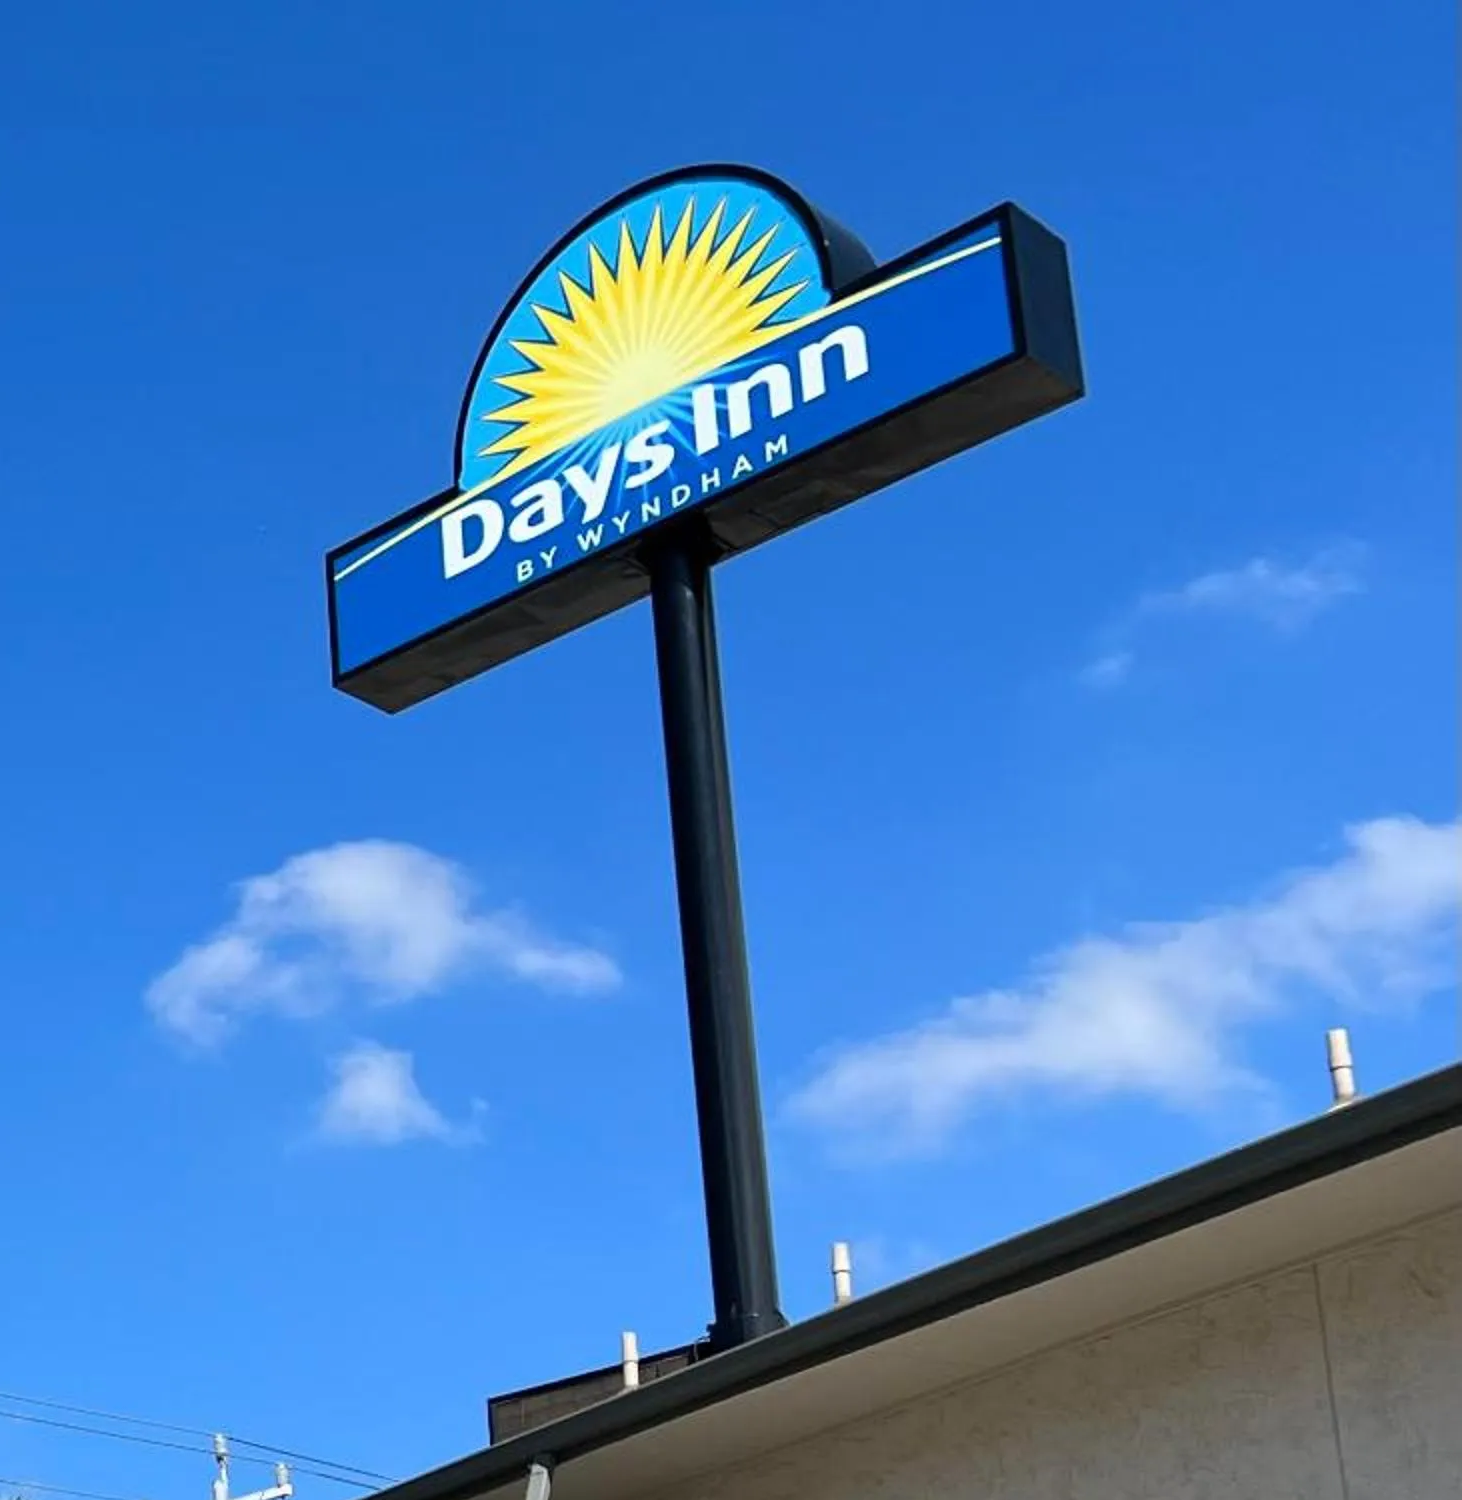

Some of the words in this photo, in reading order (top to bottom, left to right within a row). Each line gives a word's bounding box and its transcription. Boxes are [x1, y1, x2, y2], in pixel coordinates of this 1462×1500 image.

[439, 418, 676, 581] Days
[691, 323, 870, 455] Inn
[515, 545, 559, 584] BY
[575, 434, 791, 553] WYNDHAM
